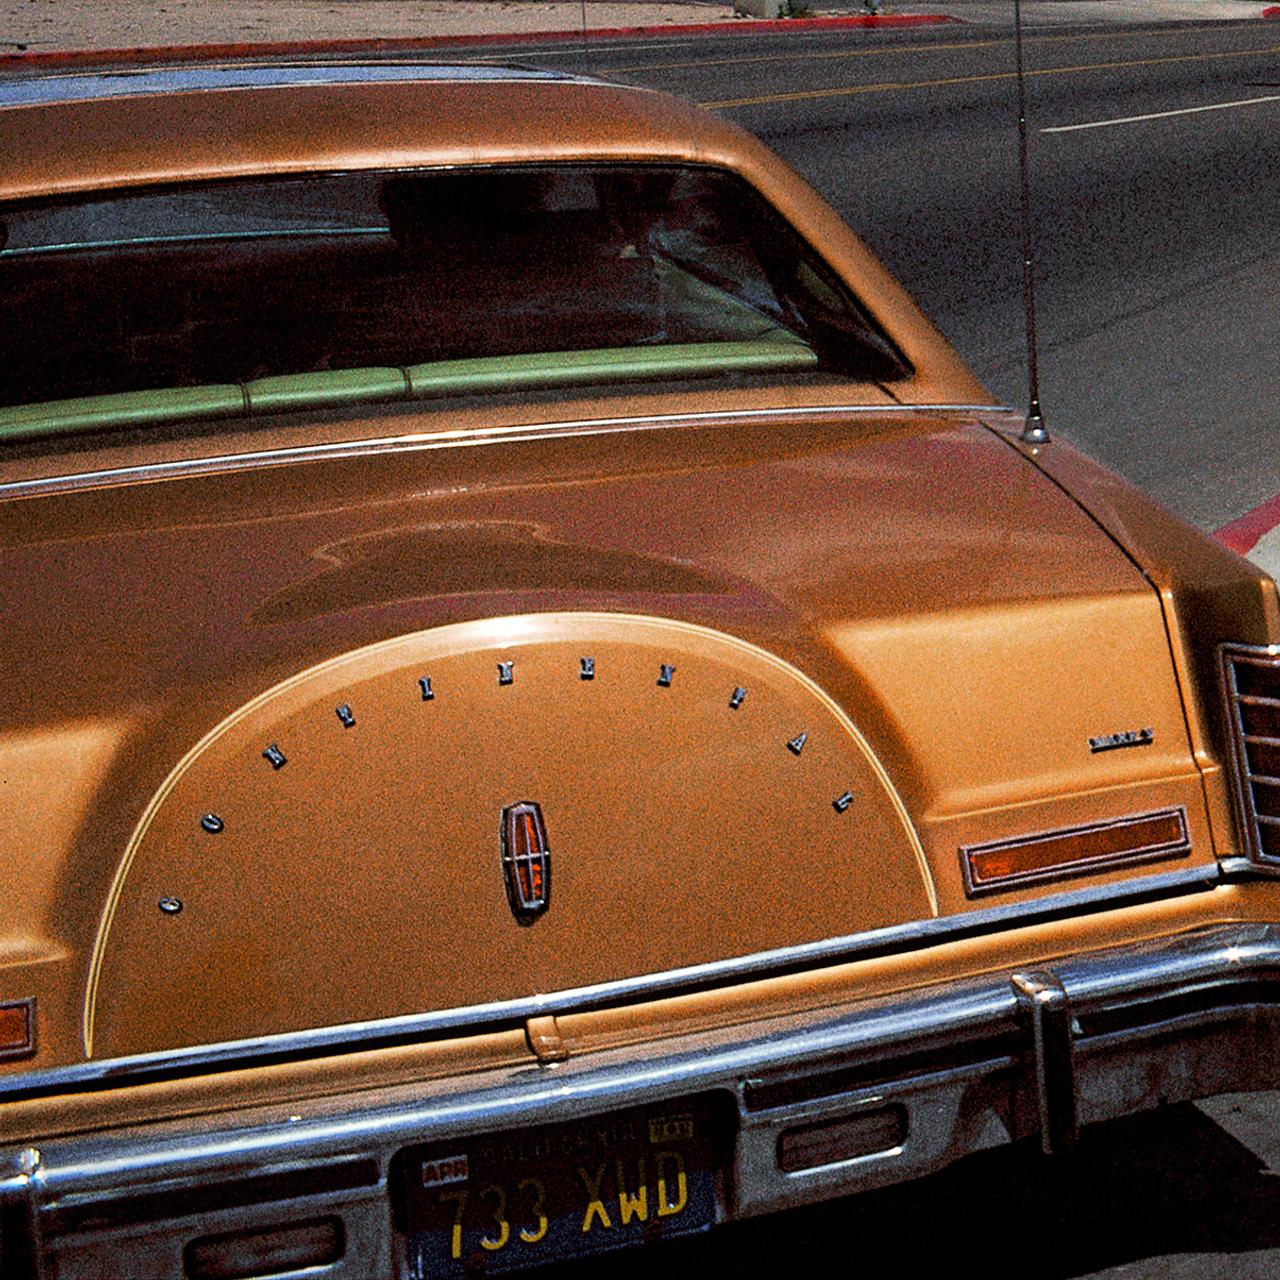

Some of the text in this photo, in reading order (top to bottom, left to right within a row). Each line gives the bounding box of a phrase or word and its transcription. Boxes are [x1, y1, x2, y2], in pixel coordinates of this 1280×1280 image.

[158, 656, 854, 916] CONTINENTAL
[439, 1150, 689, 1260] 733 XWD
